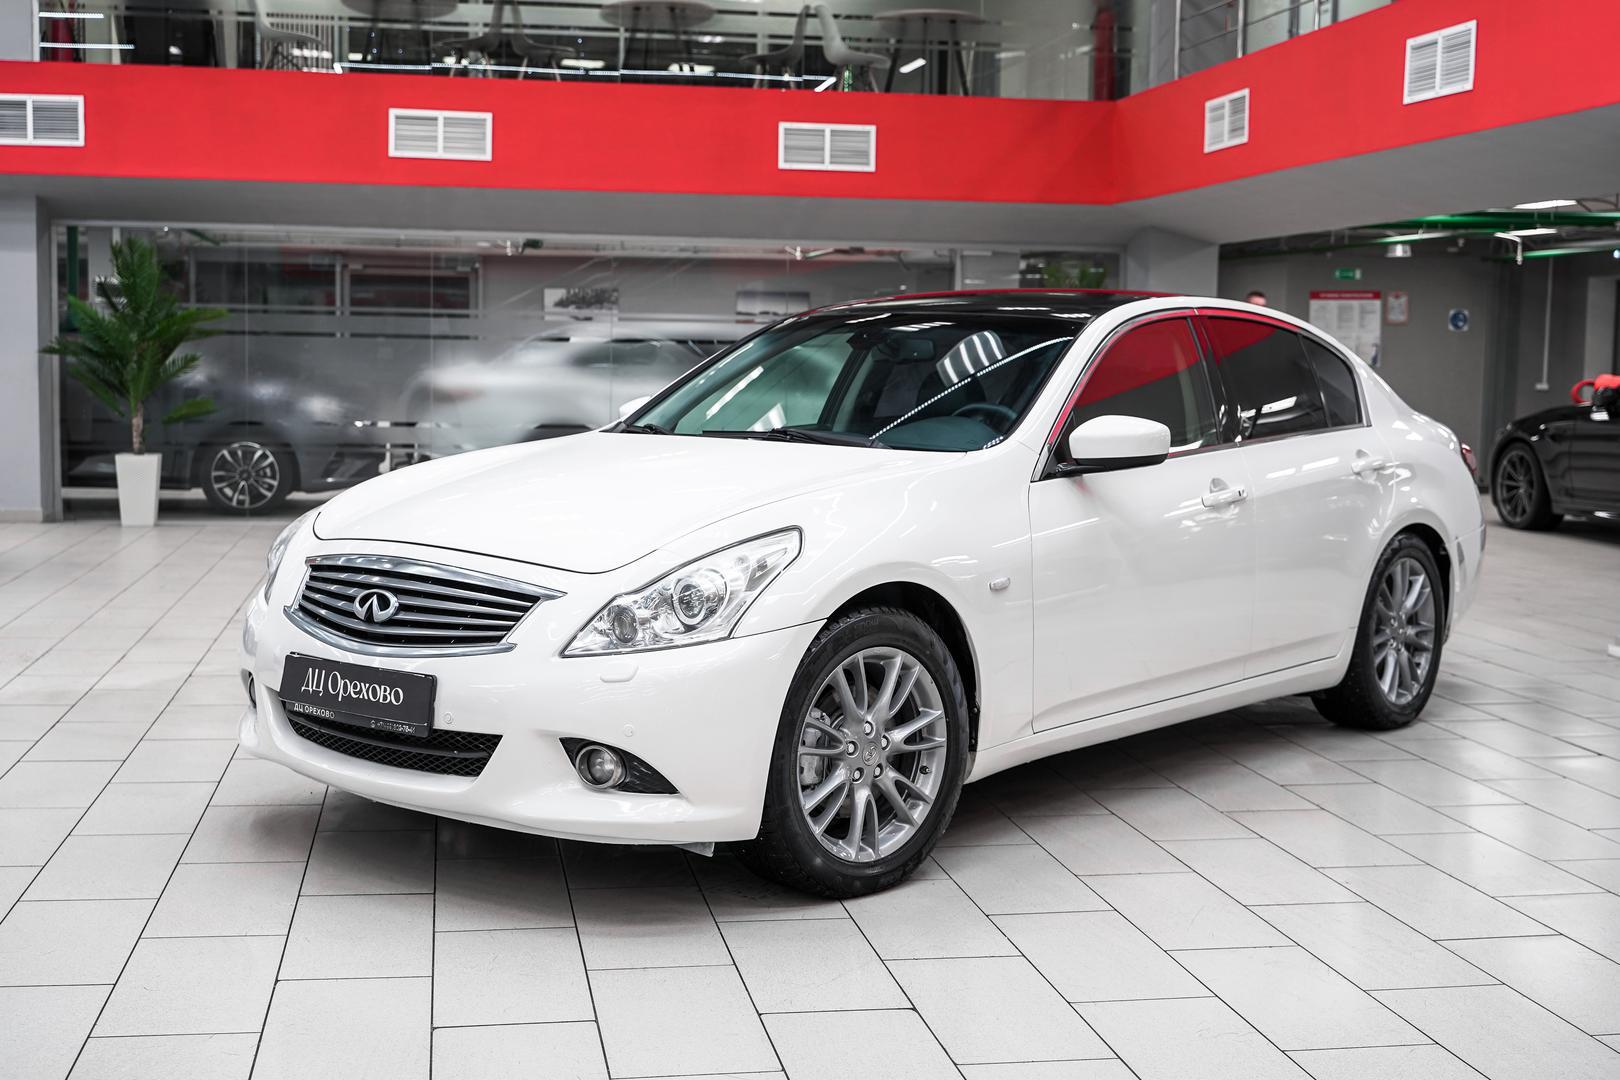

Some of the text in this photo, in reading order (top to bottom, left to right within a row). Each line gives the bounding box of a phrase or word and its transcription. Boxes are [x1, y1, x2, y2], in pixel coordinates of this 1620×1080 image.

[301, 668, 403, 705] ДЦ Орехово
[294, 703, 335, 718] ДЦ ОРЕХОВО
